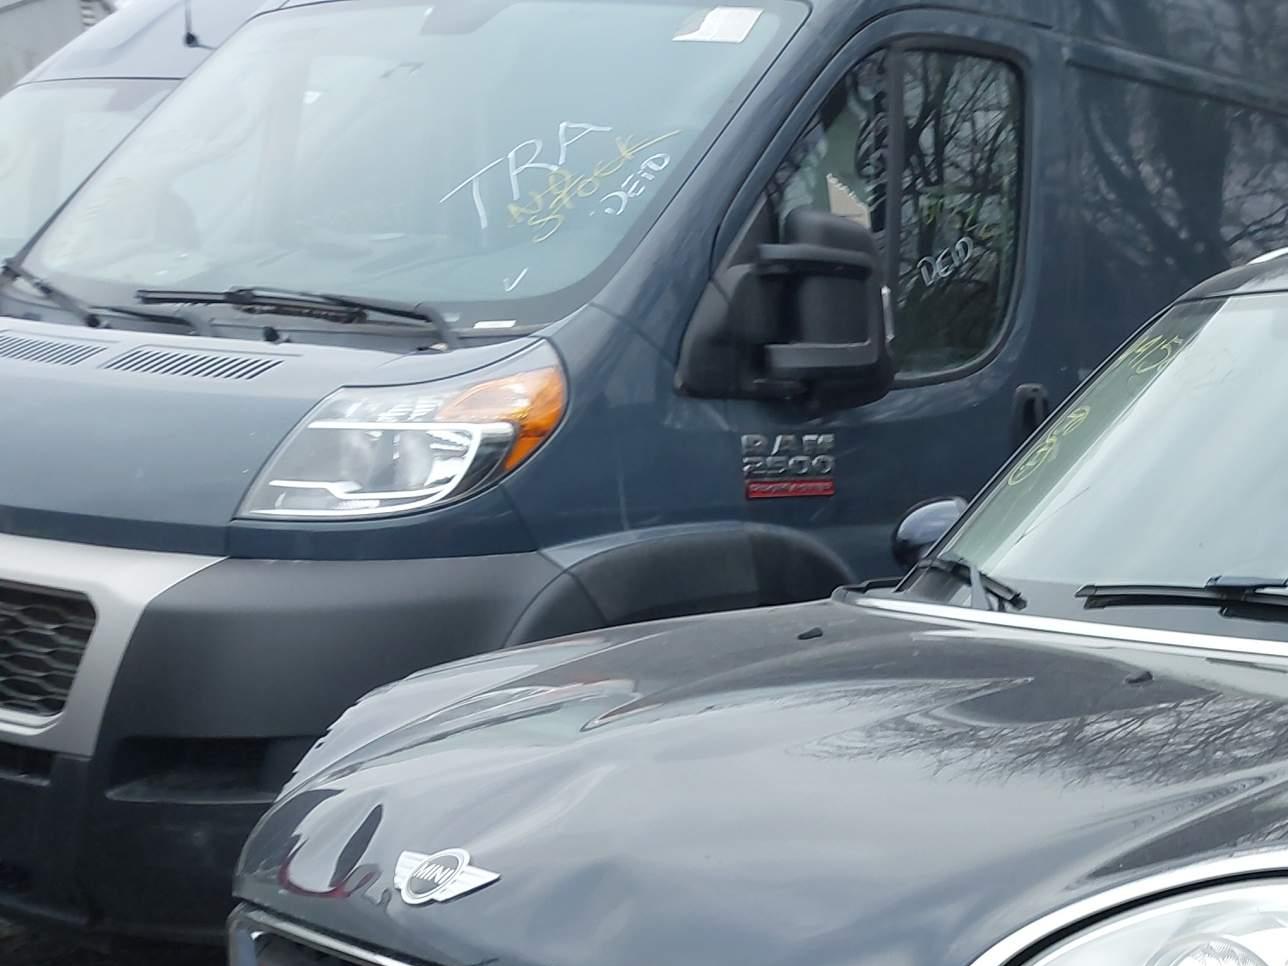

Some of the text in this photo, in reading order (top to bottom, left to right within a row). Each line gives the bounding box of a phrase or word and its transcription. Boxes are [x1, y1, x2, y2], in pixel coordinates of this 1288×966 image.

[440, 121, 613, 230] TRA
[741, 433, 835, 455] RAM
[742, 455, 835, 476] 2500
